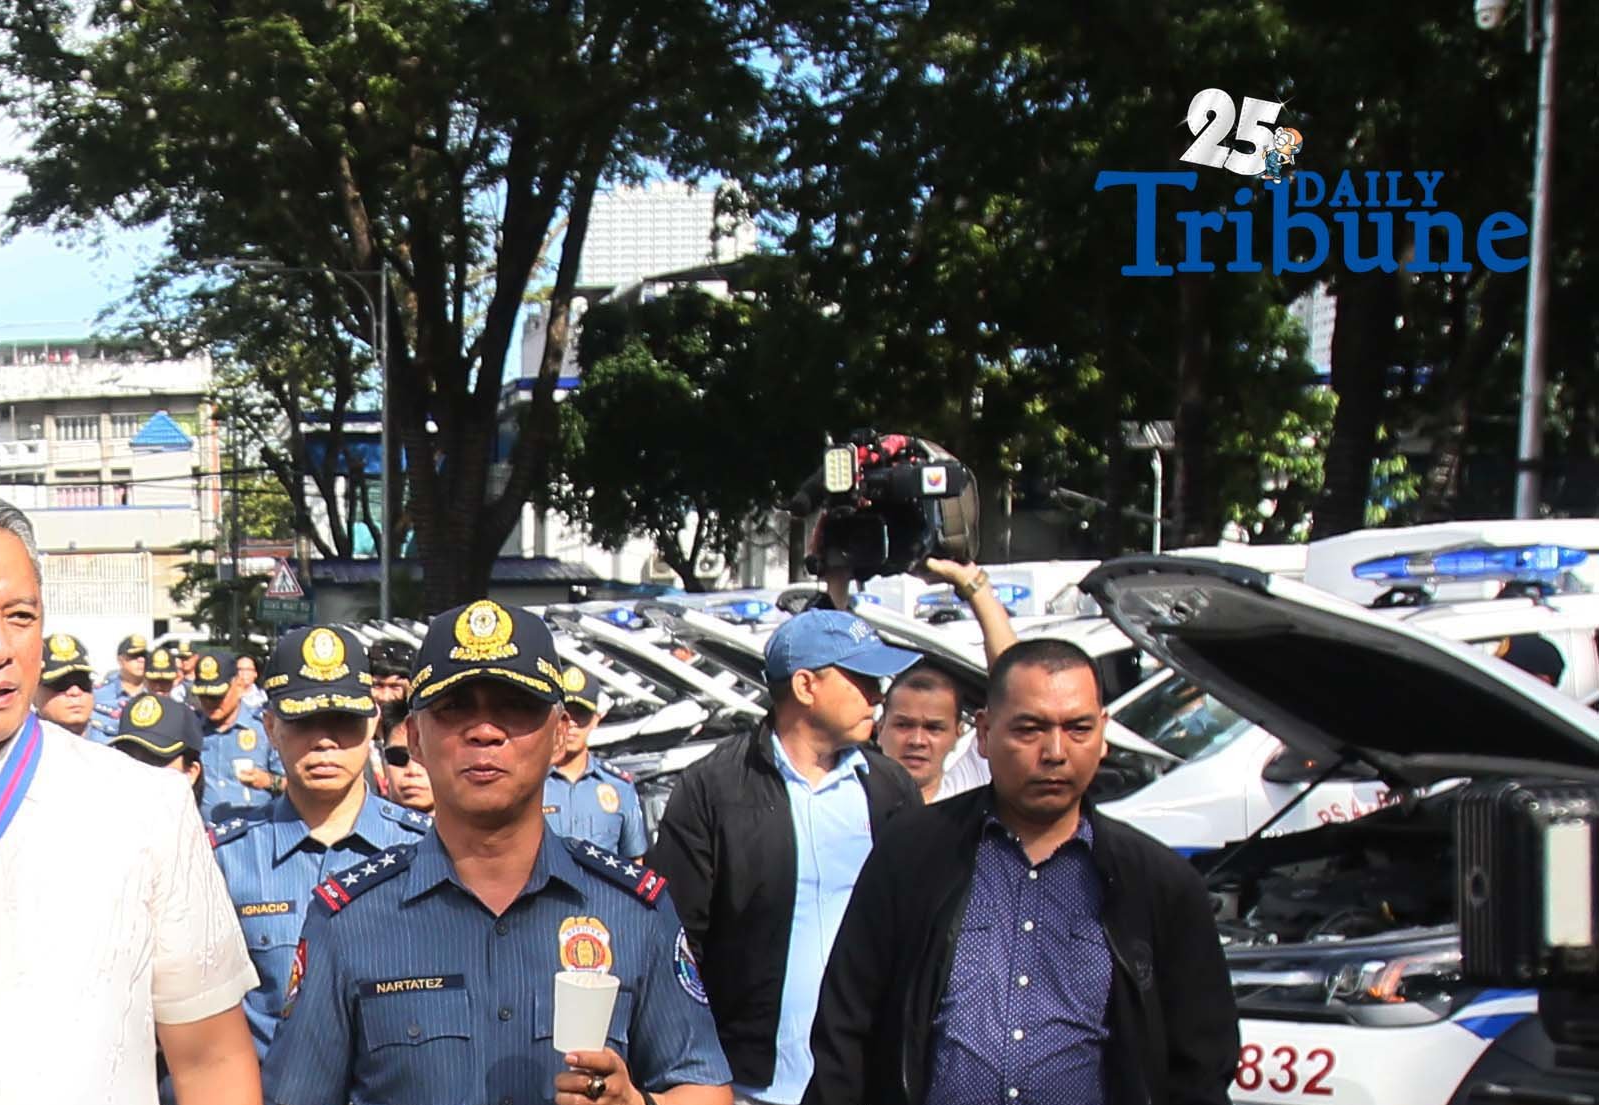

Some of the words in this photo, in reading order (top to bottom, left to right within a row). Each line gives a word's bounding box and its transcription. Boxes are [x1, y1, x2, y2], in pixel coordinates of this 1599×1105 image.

[241, 903, 289, 916] IGNACIO
[375, 978, 444, 994] NARTATEZ
[1235, 1043, 1337, 1096] 832
